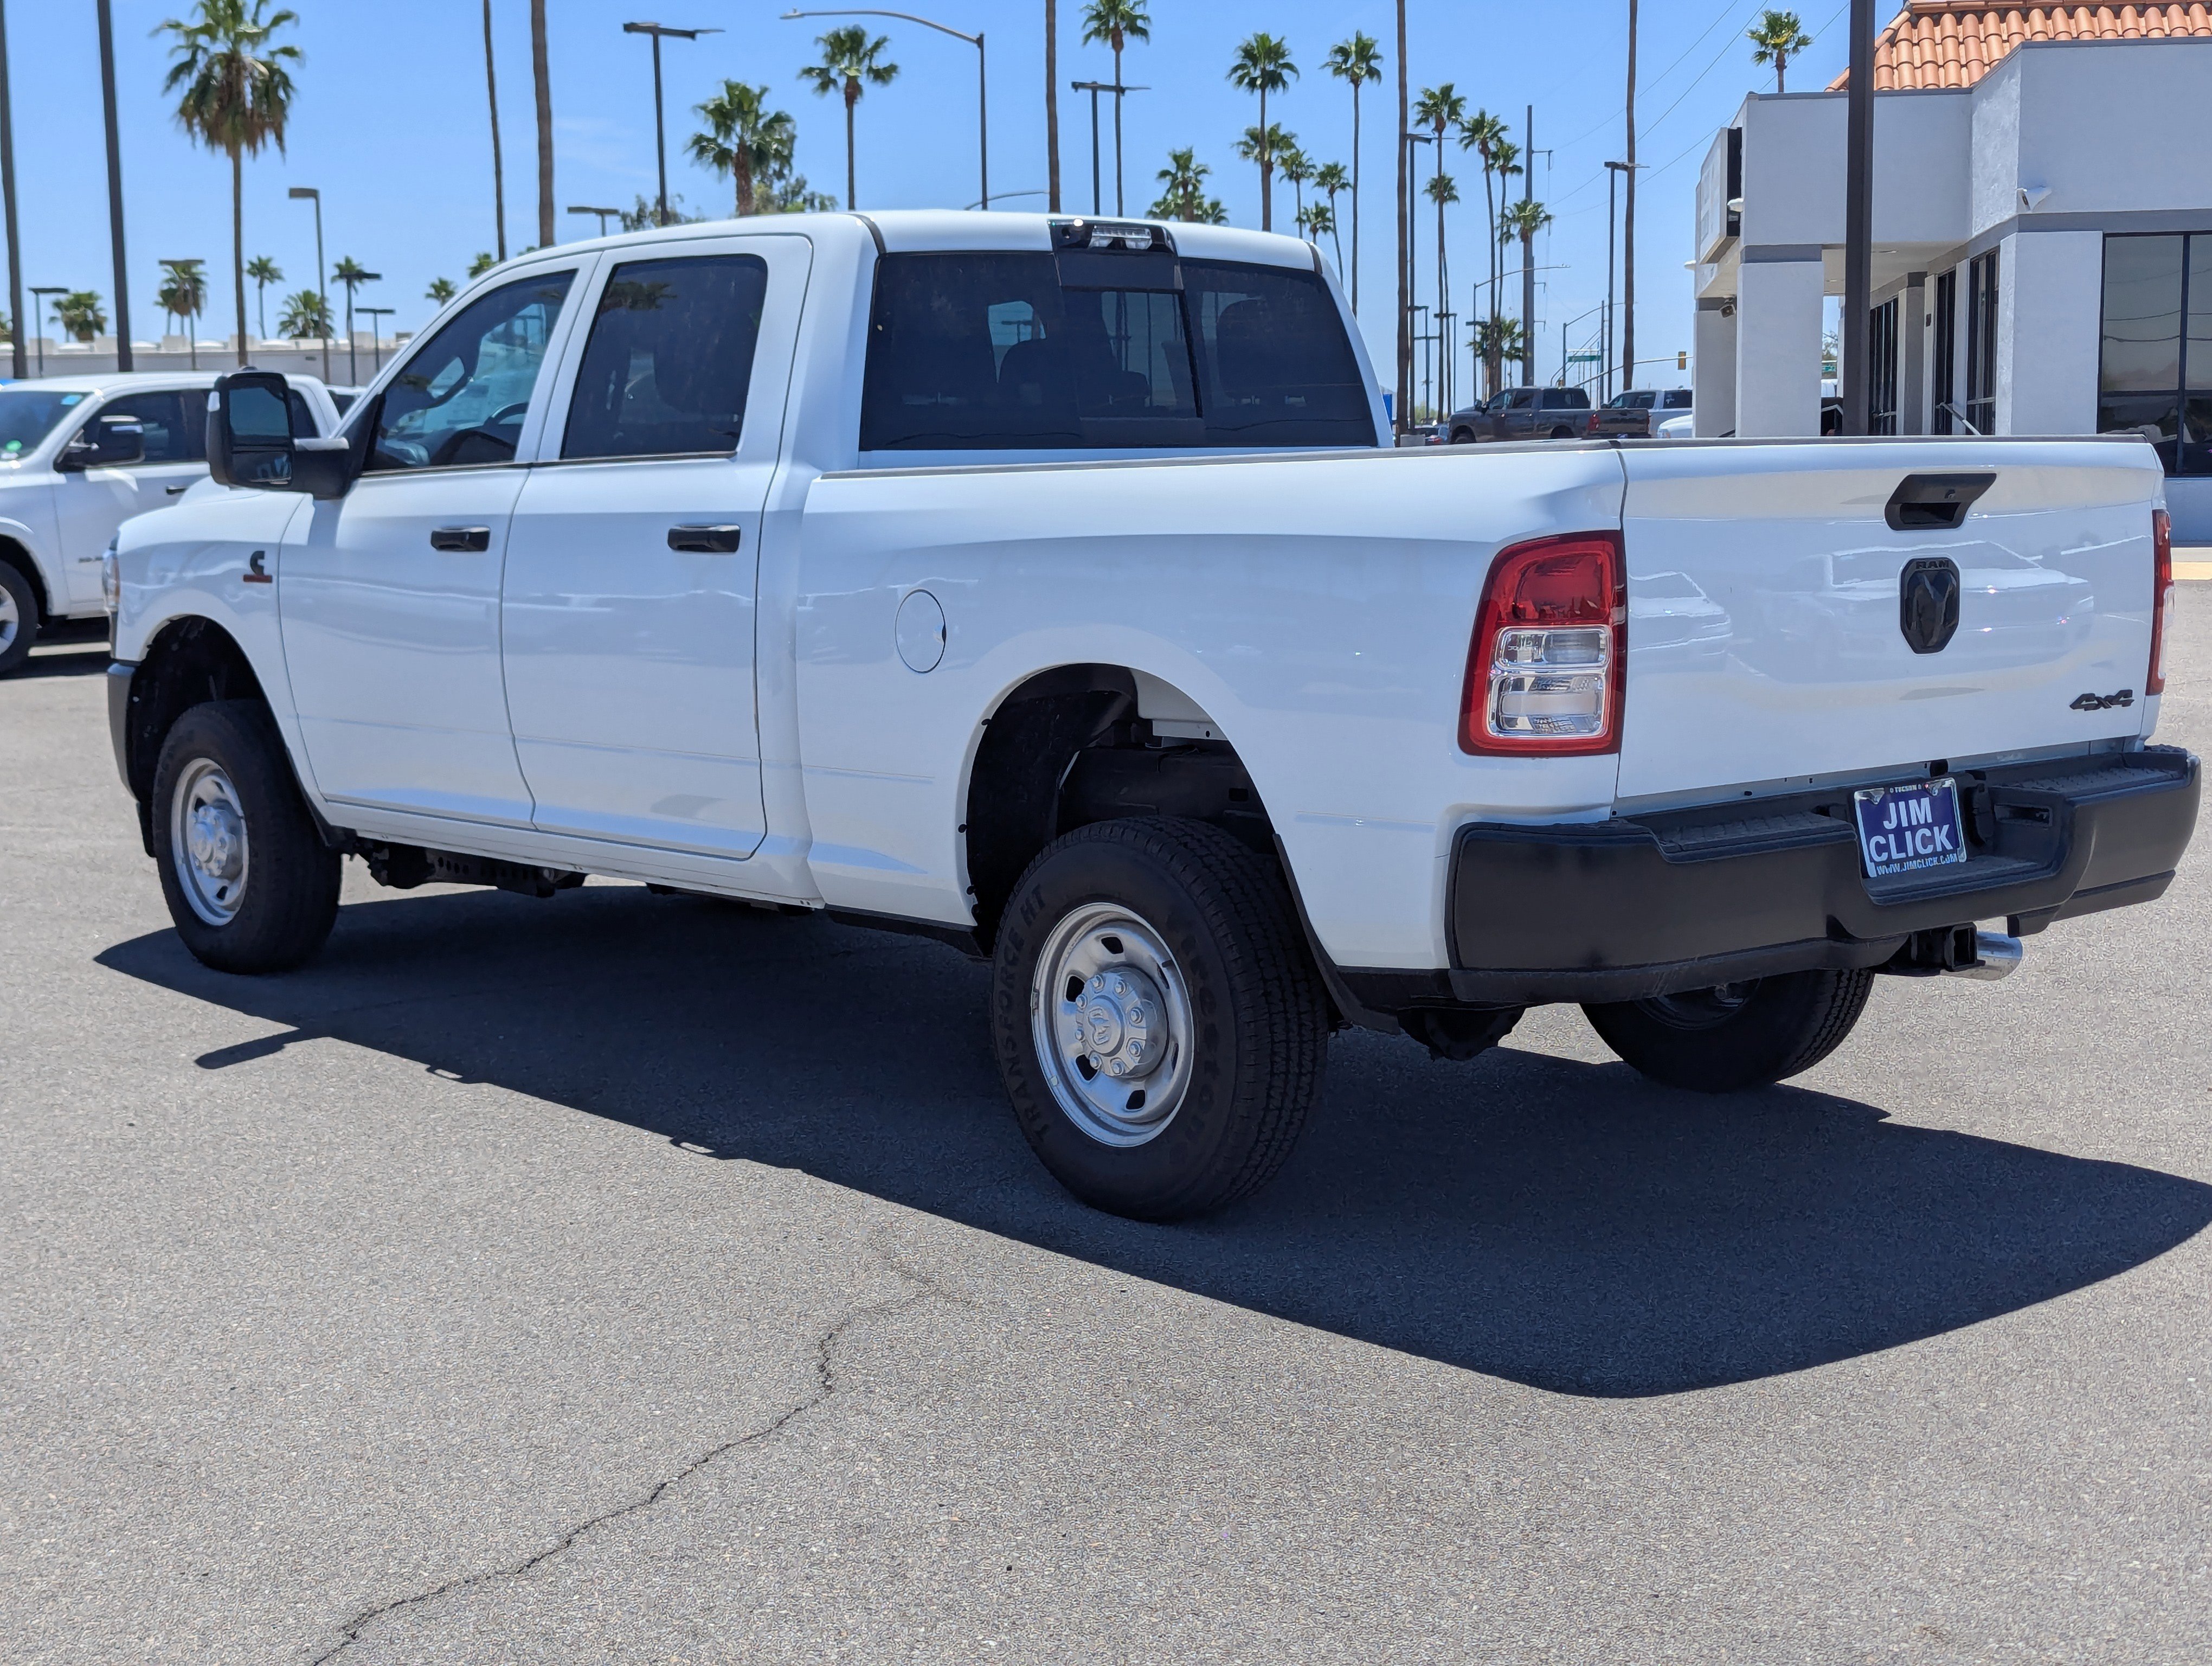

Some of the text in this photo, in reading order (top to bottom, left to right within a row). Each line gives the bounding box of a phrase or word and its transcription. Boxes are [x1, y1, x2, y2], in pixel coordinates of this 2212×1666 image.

[1916, 560, 1949, 569] RAM
[1883, 797, 1932, 830] JIM
[1869, 824, 1953, 862] CLICK
